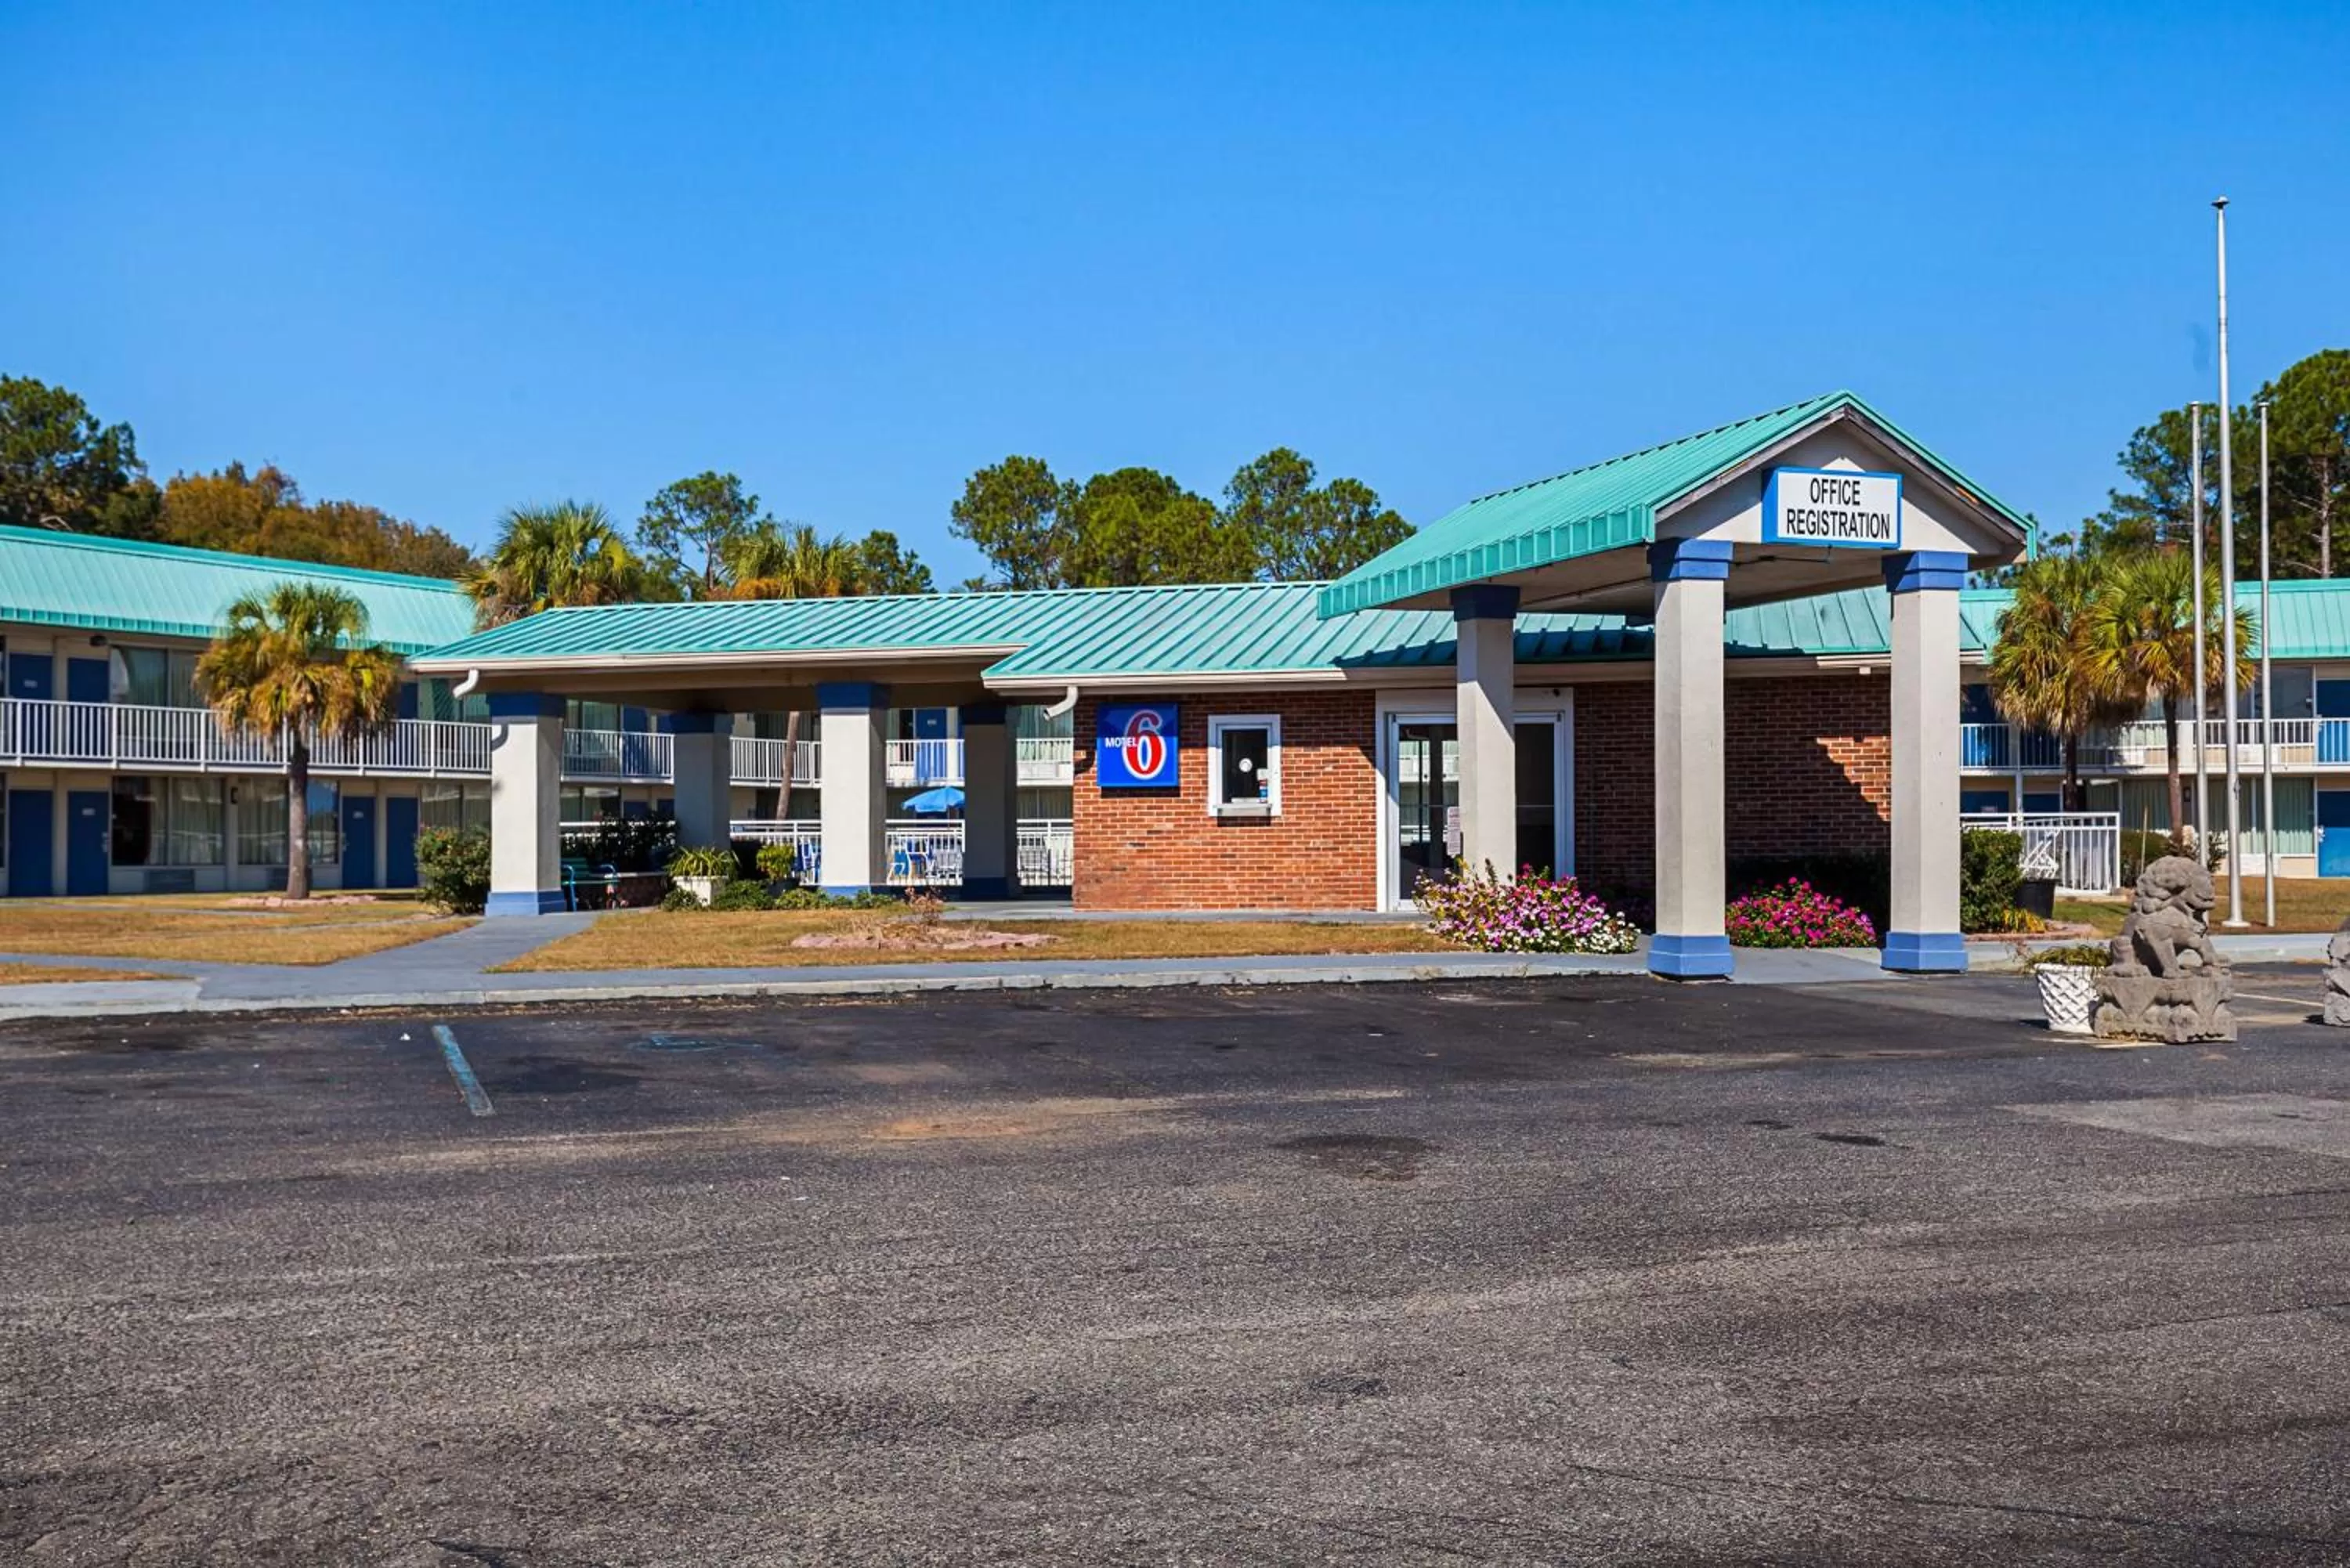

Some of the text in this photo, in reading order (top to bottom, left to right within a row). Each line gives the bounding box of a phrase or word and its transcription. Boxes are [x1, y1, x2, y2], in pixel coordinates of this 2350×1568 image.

[1810, 478, 1860, 506] OFFICE
[1787, 508, 1890, 539] REGISTRATION
[1104, 709, 1167, 780] MOTEL 6
